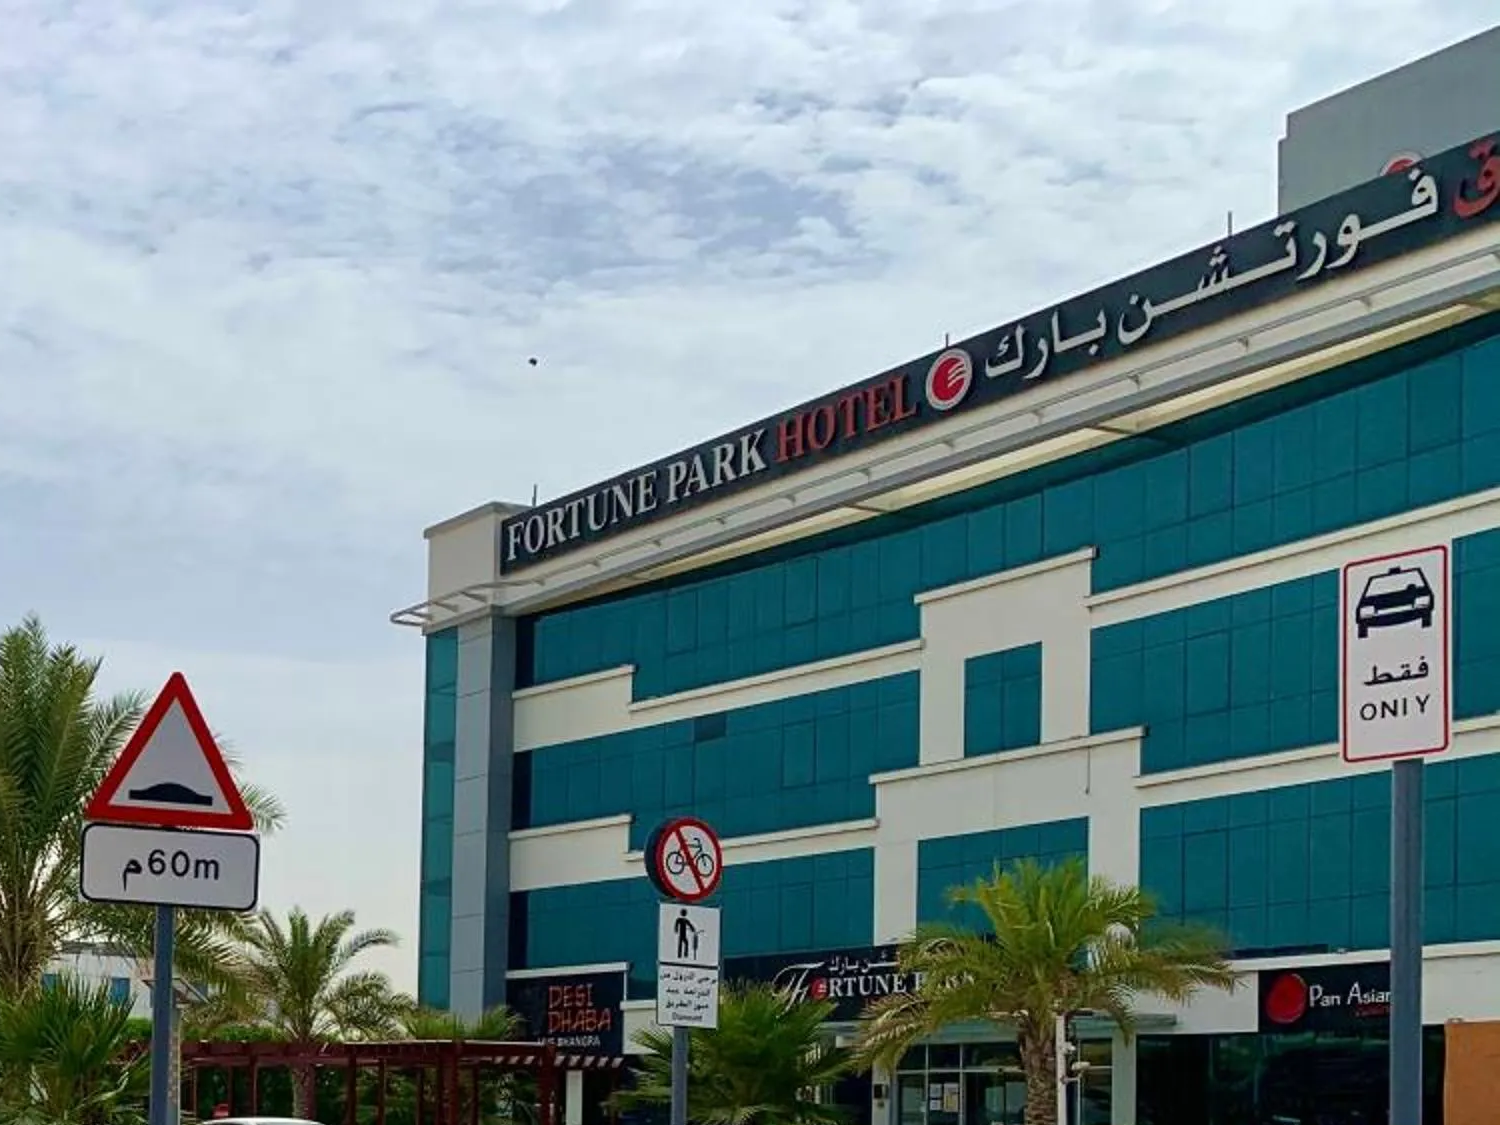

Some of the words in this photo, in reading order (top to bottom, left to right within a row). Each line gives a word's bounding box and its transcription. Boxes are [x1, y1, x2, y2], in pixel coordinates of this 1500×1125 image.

[984, 309, 1106, 379] بارك
[507, 470, 658, 561] FORTUNE
[668, 429, 767, 503] PARK
[776, 374, 918, 462] HOTEL
[1363, 656, 1429, 686] فقط
[548, 983, 594, 1009] DESI
[1309, 984, 1341, 1008] Pan
[548, 1007, 613, 1034] DHABA
